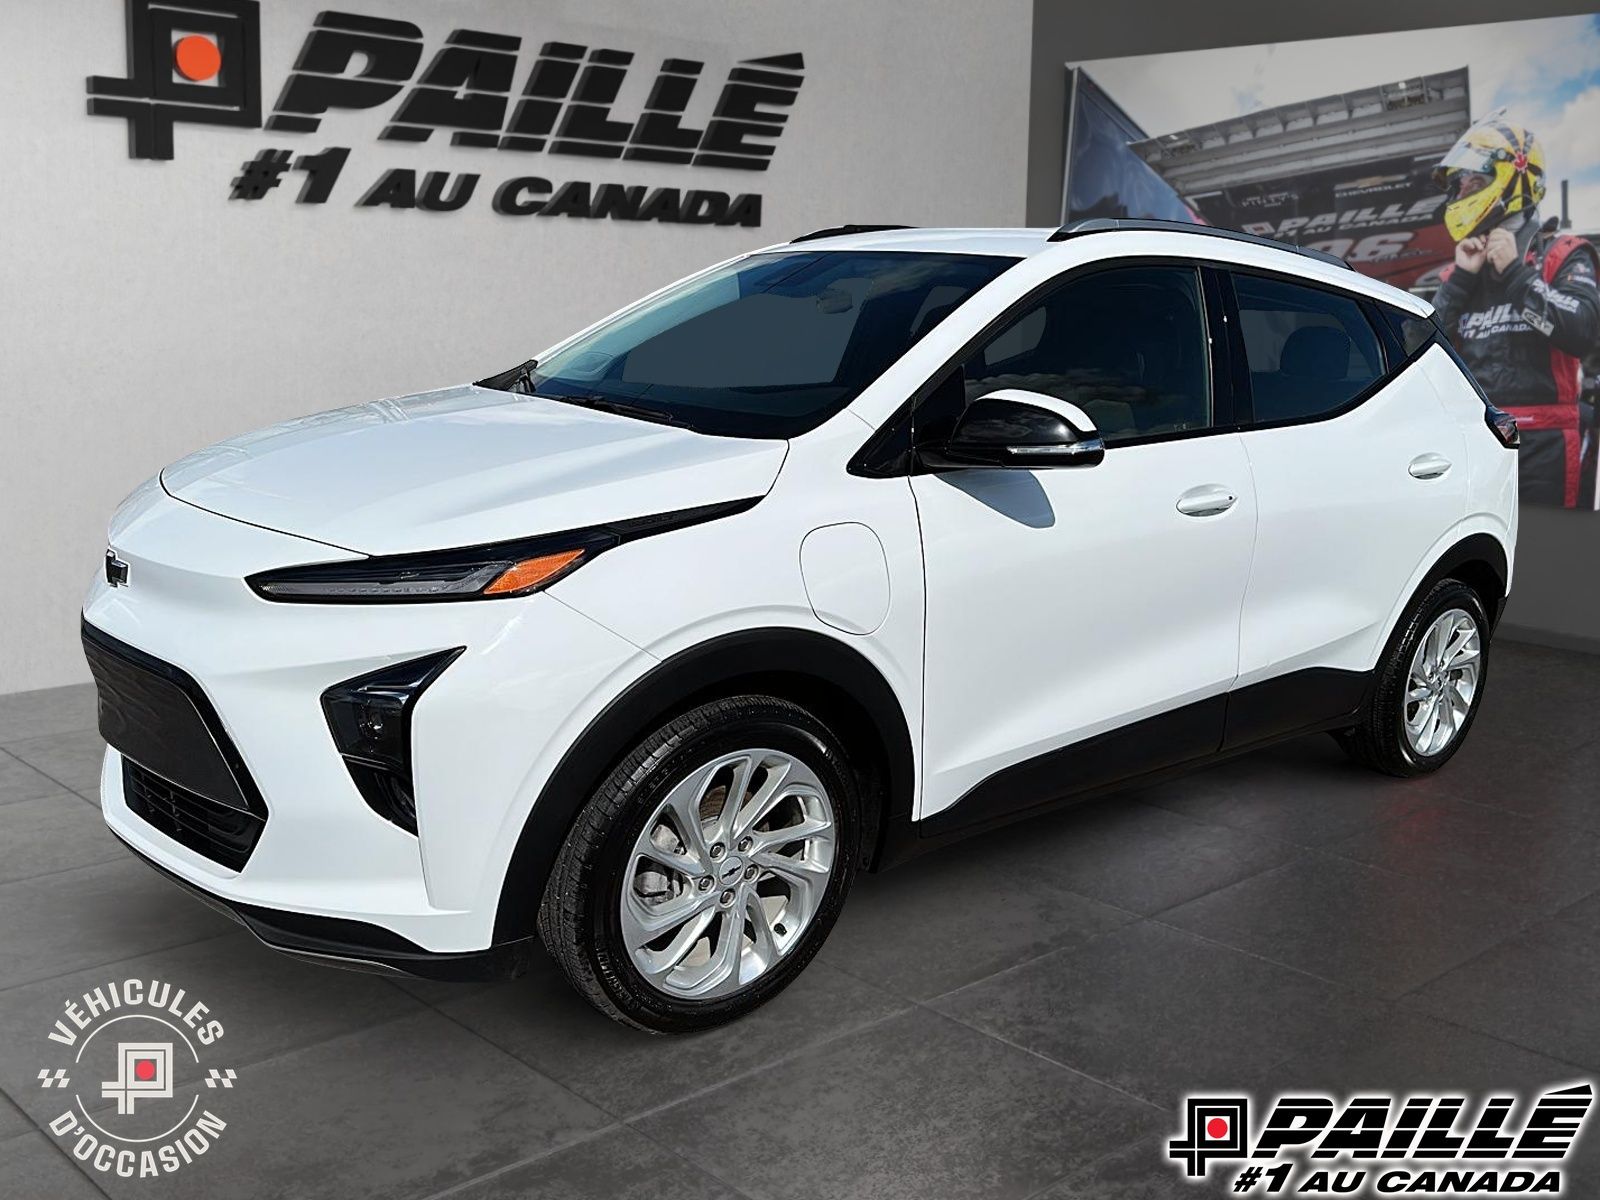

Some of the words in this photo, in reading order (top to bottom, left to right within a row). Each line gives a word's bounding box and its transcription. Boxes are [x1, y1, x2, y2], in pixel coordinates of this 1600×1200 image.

[264, 10, 806, 171] PAILLÉ
[228, 147, 352, 205] #1
[354, 168, 481, 212] AU
[491, 176, 764, 228] CANADA
[1334, 182, 1412, 199] CHEVROLET
[1339, 213, 1433, 231] CANADA
